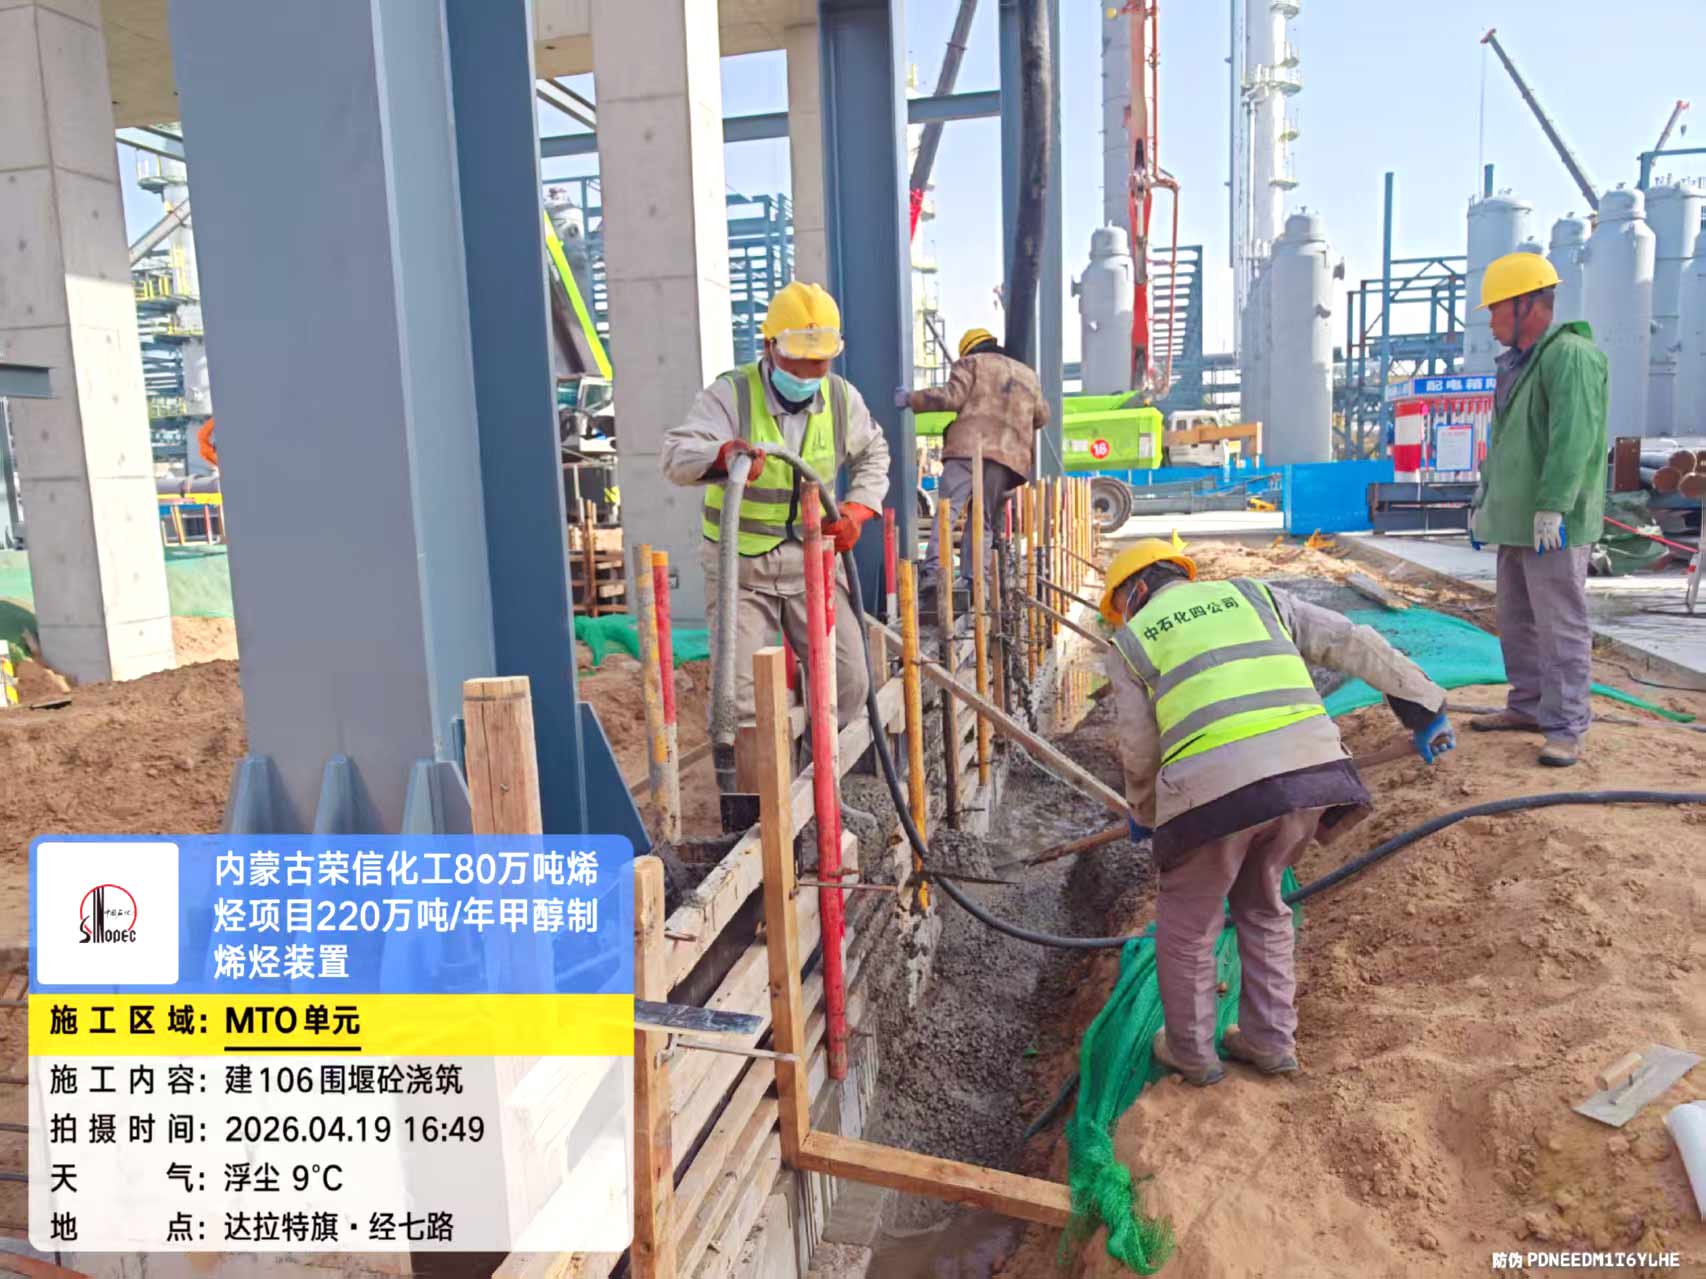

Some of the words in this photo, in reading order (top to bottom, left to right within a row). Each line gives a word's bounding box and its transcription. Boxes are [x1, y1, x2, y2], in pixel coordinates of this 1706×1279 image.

[1143, 597, 1239, 641] 中石化四公司
